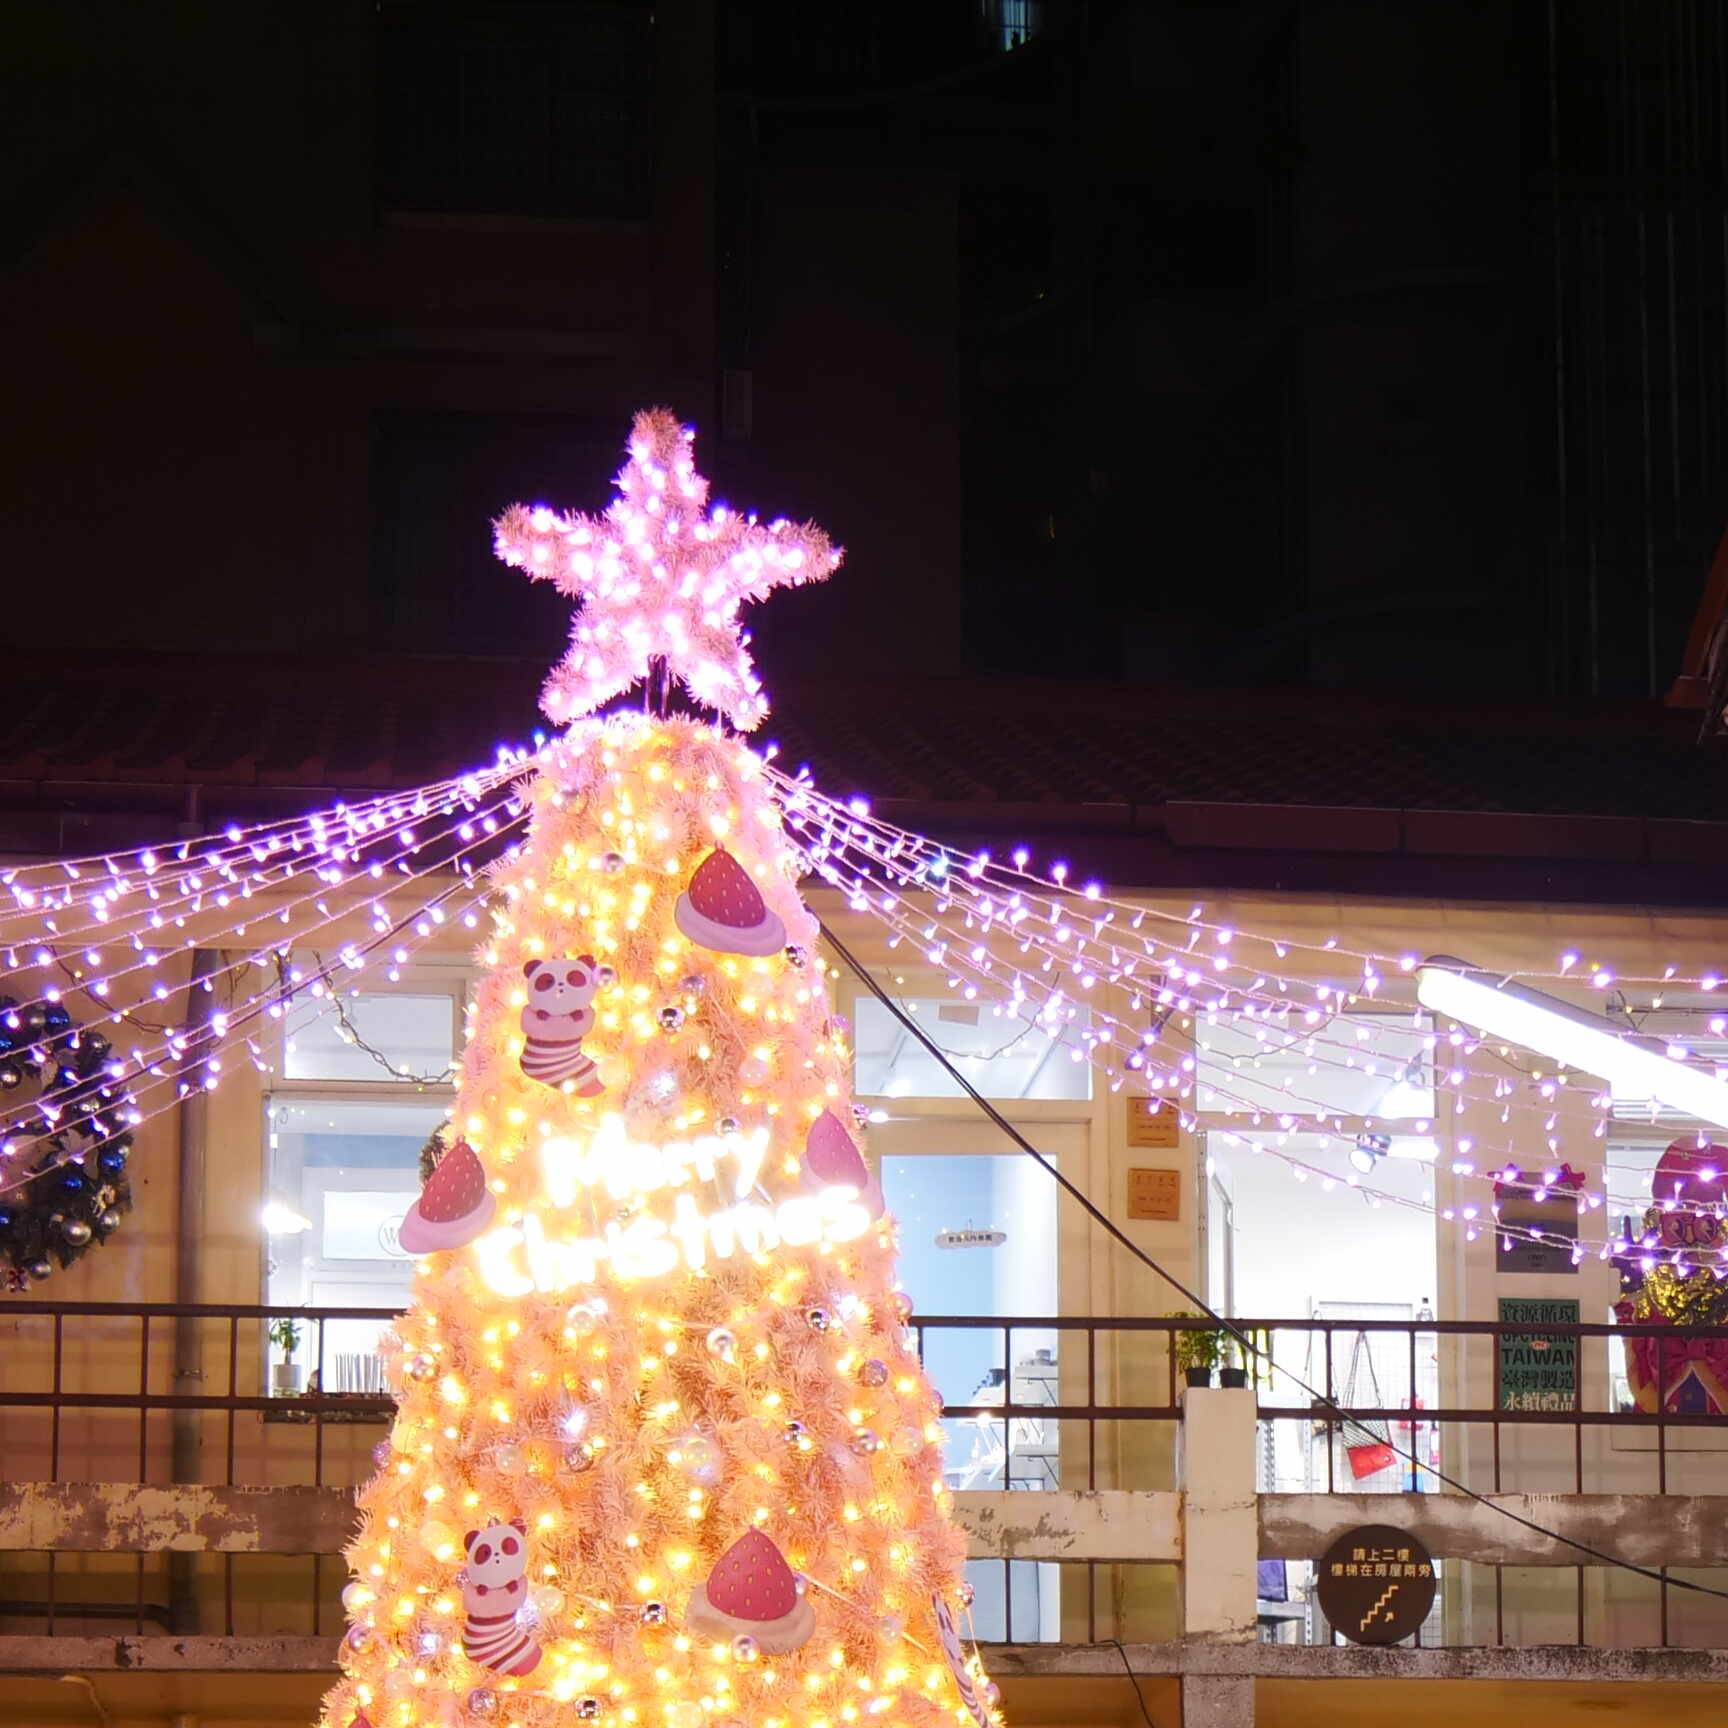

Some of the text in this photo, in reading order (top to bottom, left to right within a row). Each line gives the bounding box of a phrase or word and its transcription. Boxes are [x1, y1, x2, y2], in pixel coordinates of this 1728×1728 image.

[542, 1116, 770, 1207] Merry
[478, 1184, 871, 1297] Christmas
[1352, 1548, 1410, 1562] 請上二樓
